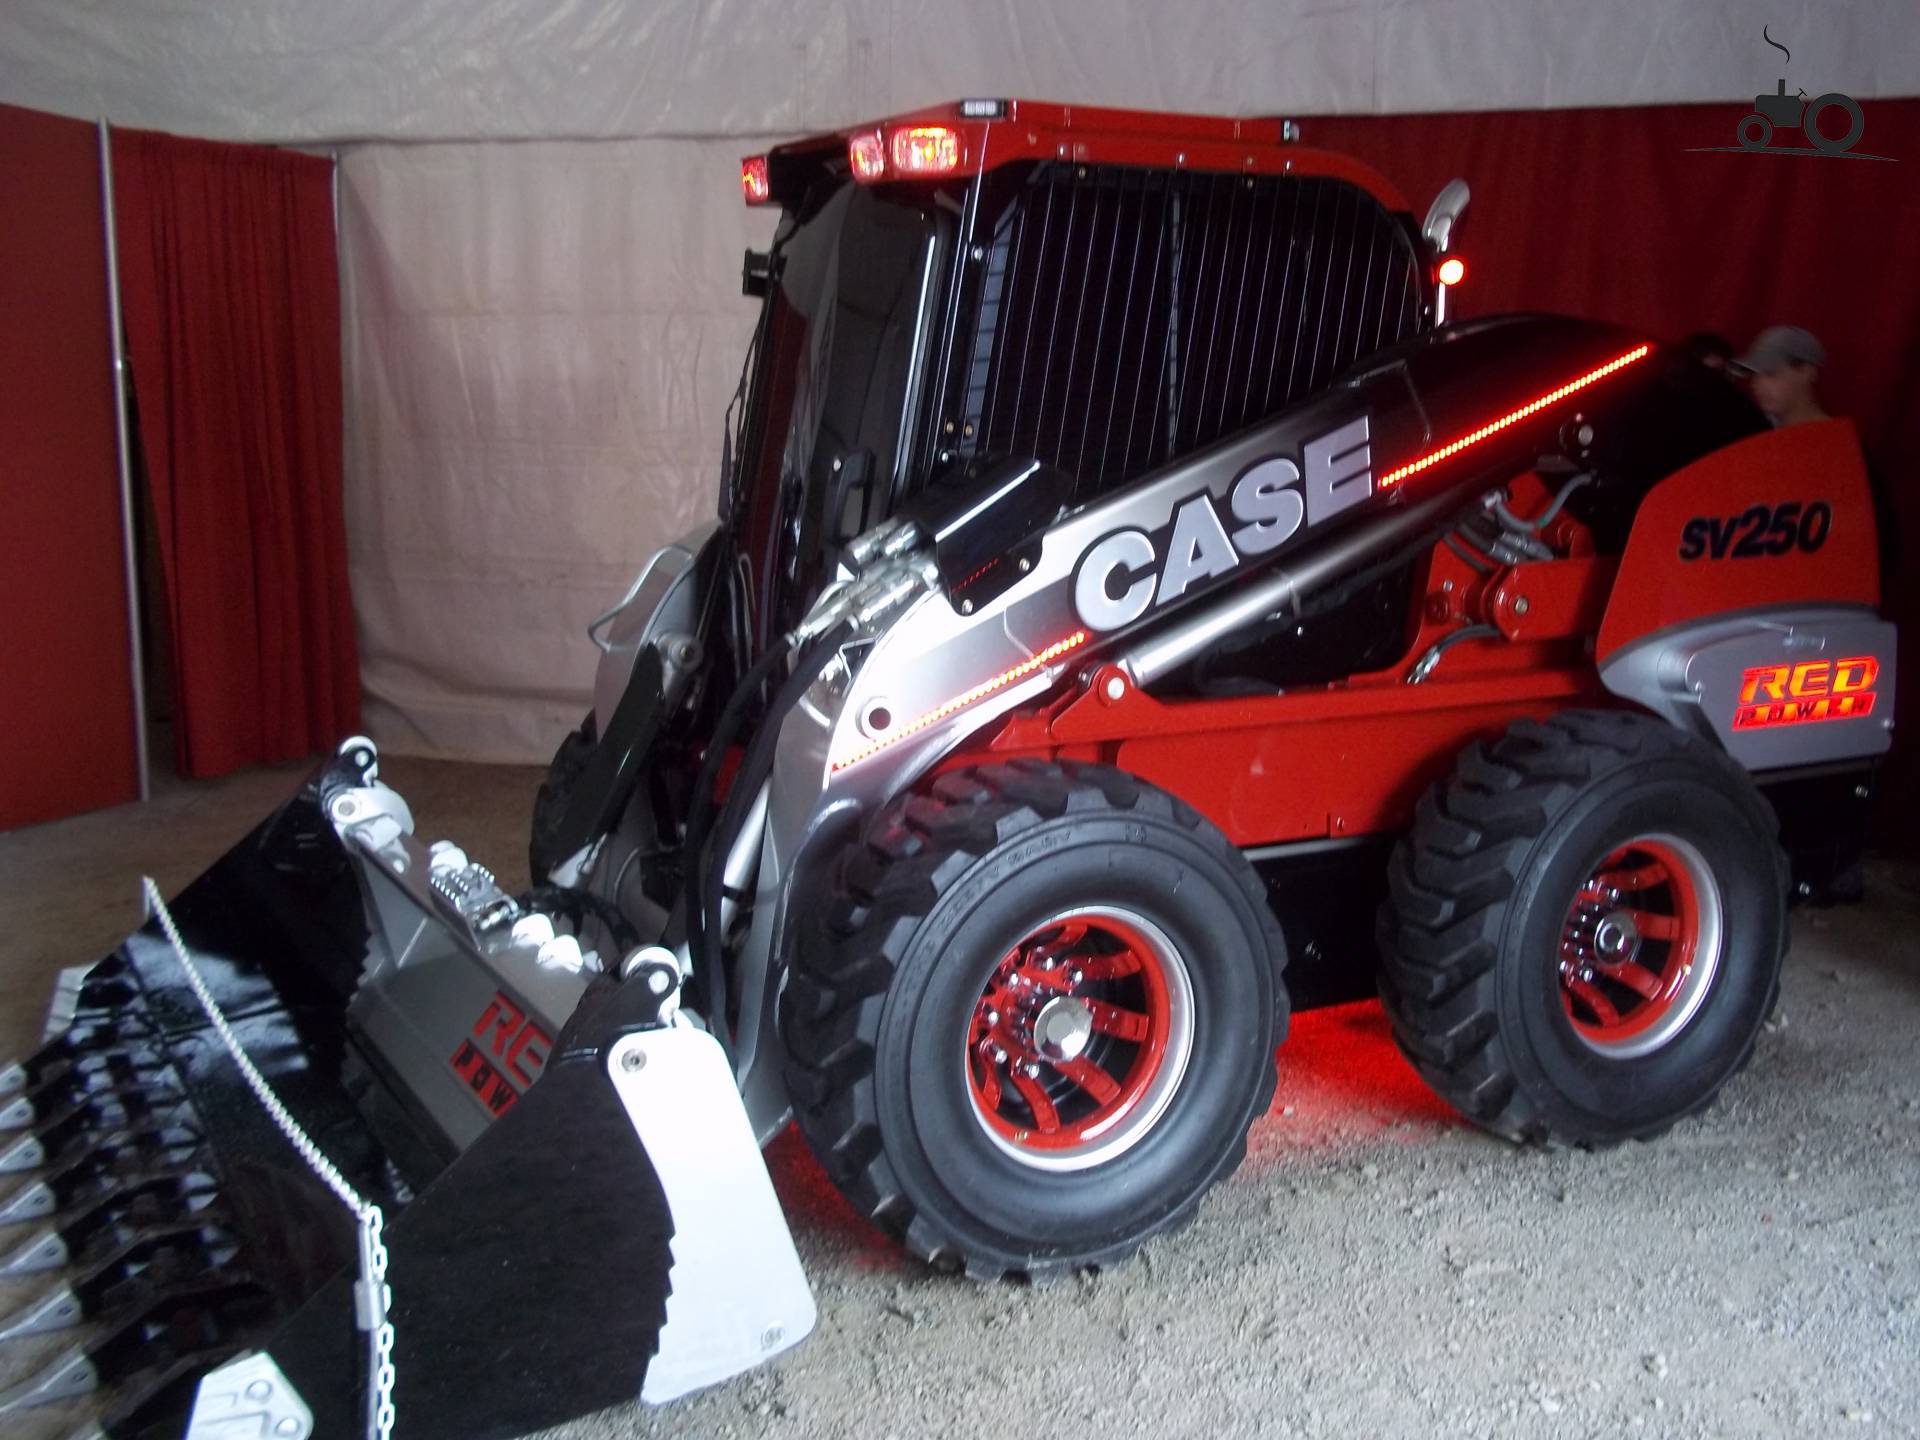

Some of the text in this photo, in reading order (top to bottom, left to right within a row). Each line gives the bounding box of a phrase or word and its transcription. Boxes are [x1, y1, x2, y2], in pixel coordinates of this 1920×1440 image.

[1074, 414, 1372, 632] CASE
[1677, 501, 1832, 562] SV250
[1738, 656, 1880, 705] RED
[1735, 695, 1873, 729] POWER
[471, 990, 554, 1090] RE
